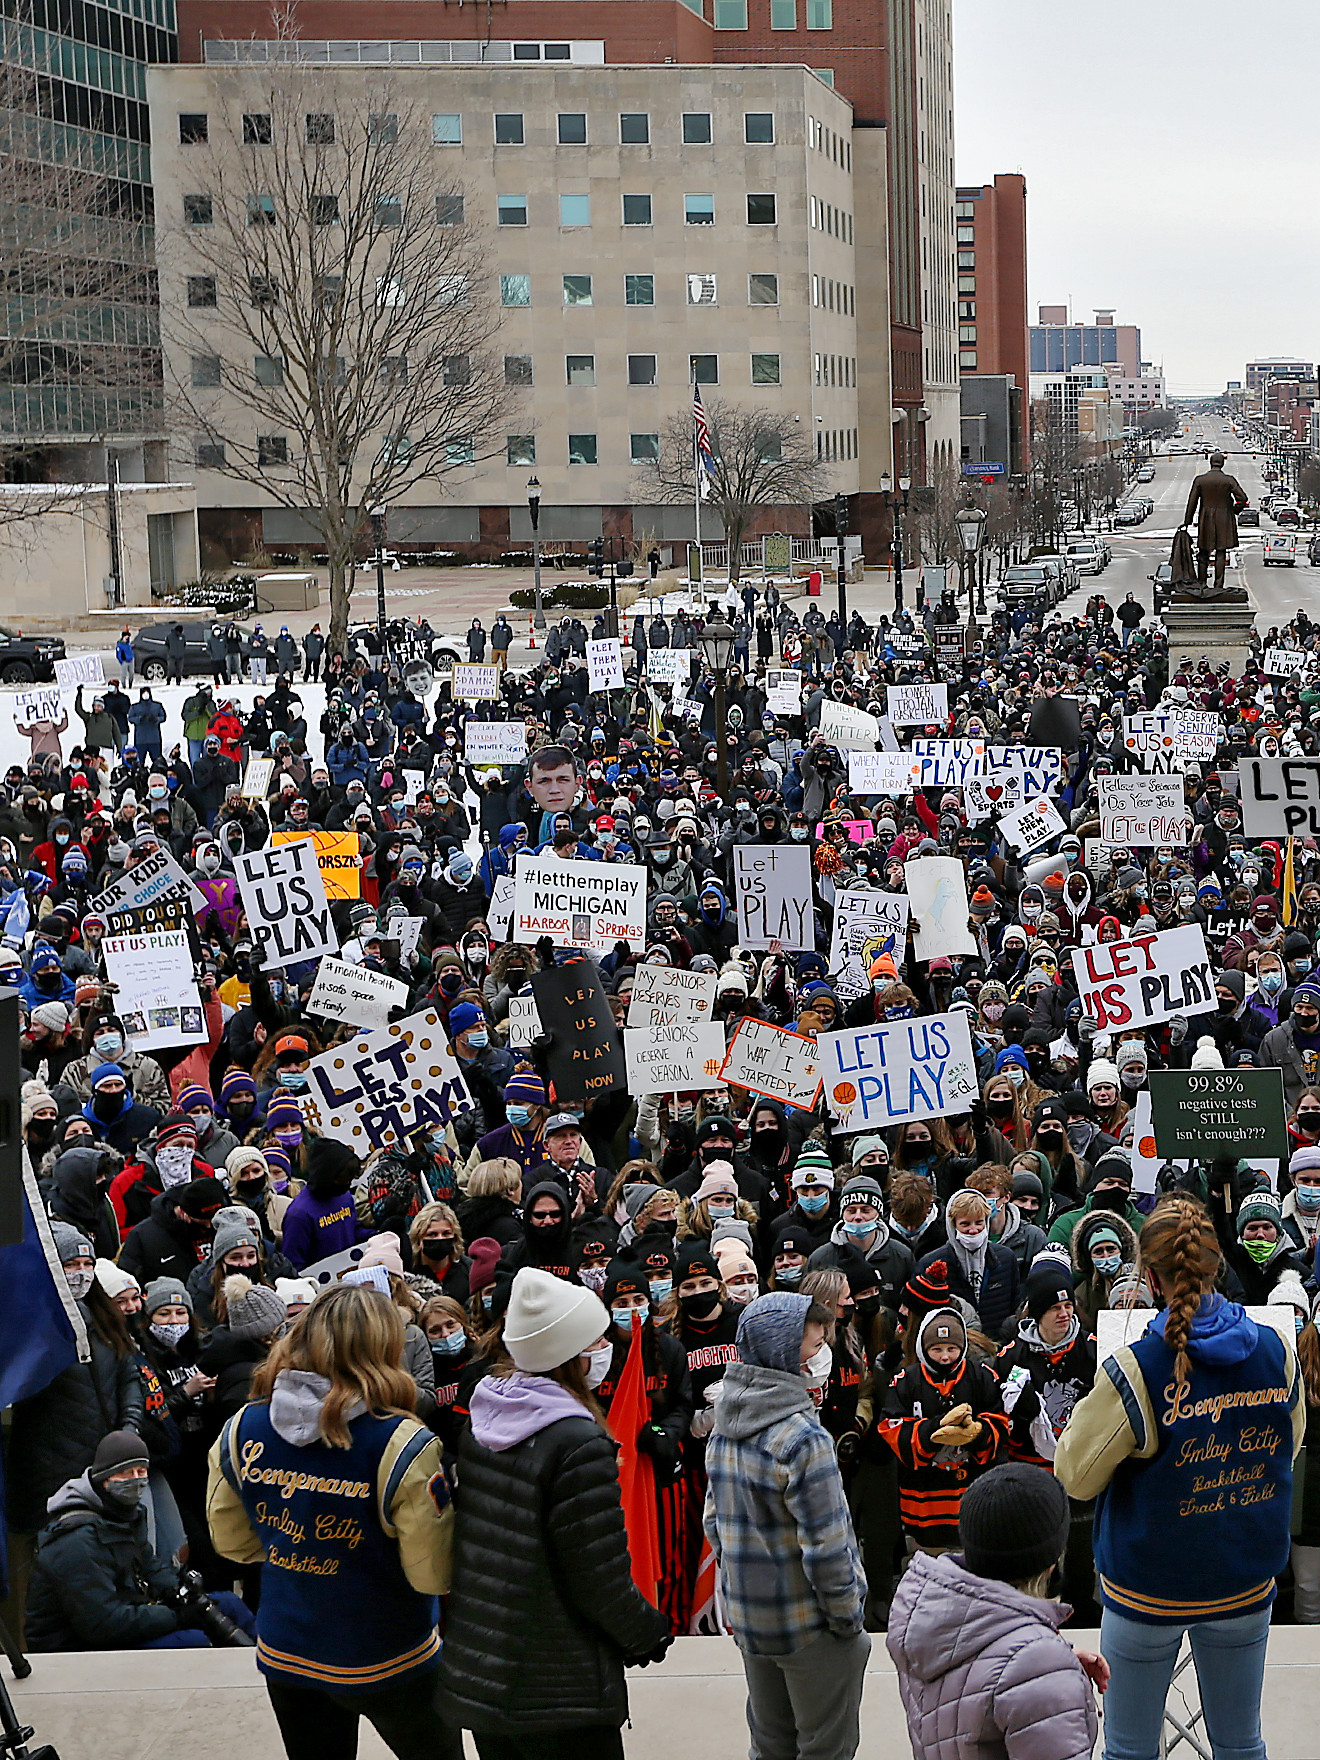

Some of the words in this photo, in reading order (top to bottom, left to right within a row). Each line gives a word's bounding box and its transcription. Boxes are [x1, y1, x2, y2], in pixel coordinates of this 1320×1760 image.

[596, 643, 613, 653] LET
[593, 655, 617, 664] THEM
[1271, 661, 1298, 675] PLAY
[457, 666, 473, 676] FIX
[478, 666, 495, 676] THE
[461, 676, 490, 685] DAMN
[594, 666, 617, 676] PLAY
[16, 693, 37, 706] LET
[38, 689, 61, 703] THEM
[455, 687, 496, 697] SPORTS!
[26, 700, 59, 721] PLAY
[1175, 710, 1217, 723] DESERVE
[822, 722, 877, 741] MATTER!
[1128, 715, 1170, 734] LET
[915, 741, 950, 757] LET
[953, 740, 974, 760] US
[1138, 733, 1161, 752] US
[1174, 734, 1216, 747] SEASON
[853, 755, 880, 767] WHEN
[988, 747, 1026, 769] LET
[1028, 746, 1060, 769] US
[864, 768, 876, 778] IT
[884, 768, 896, 778] BE
[921, 759, 980, 785] PLAY!
[862, 779, 878, 790] MY
[1102, 778, 1133, 793] Follow
[977, 801, 1014, 811] SPORTS
[1108, 795, 1126, 811] Do
[1156, 796, 1175, 809] Job
[1018, 812, 1036, 827] LET
[1019, 818, 1044, 835] THEM
[1102, 816, 1137, 843] LET
[1149, 816, 1186, 842] PLAY
[1025, 824, 1051, 844] PLAY!
[243, 842, 308, 883] LET
[739, 850, 779, 873] Let
[92, 885, 127, 914] OUR
[129, 852, 169, 887] KIDS
[134, 873, 173, 904] CHOICE
[524, 869, 639, 896] #letthemplay
[255, 876, 314, 922] US
[534, 892, 628, 916] MICHIGAN
[838, 894, 869, 915] LET
[875, 900, 901, 923] US
[112, 914, 133, 931] DID
[138, 906, 165, 923] YOU
[166, 902, 187, 917] GET
[519, 914, 570, 931] HARBOR
[595, 917, 643, 938] SPRINGS
[743, 896, 809, 949] PLAY
[1207, 914, 1237, 937] Let
[253, 909, 329, 958] PLAY
[563, 938, 605, 949] Rams!!
[105, 940, 125, 954] LET
[129, 938, 147, 951] US
[149, 934, 185, 949] PLAY!
[1085, 936, 1158, 983] LET
[369, 972, 395, 991] health
[663, 971, 707, 992] SENIOR
[351, 990, 376, 1001] space
[565, 987, 596, 1006] LET
[633, 988, 680, 1009] DESERVES
[1083, 984, 1133, 1031] US
[1140, 963, 1212, 1017] PLAY
[576, 1017, 597, 1031] US
[740, 1019, 765, 1040] LET
[771, 1031, 792, 1049] ME
[650, 1026, 699, 1044] SENIORS
[572, 1043, 612, 1061] PLAY
[636, 1047, 670, 1064] DESERVE
[686, 1047, 694, 1059] A
[834, 1030, 890, 1074] LET
[908, 1021, 950, 1062] US
[651, 1065, 694, 1083] SEASON.
[781, 1056, 794, 1073] I
[312, 1040, 410, 1110] LET
[585, 1073, 614, 1089] NOW
[738, 1065, 797, 1097] STARTED!
[1188, 1075, 1244, 1093] 99.8%
[859, 1061, 947, 1120] PLAY
[359, 1076, 472, 1149] PLAY!
[1179, 1097, 1228, 1112] negative
[1230, 1098, 1257, 1110] tests
[1199, 1113, 1240, 1125] STILL
[1176, 1127, 1201, 1140] isn't
[1203, 1127, 1266, 1143] enough???
[318, 1206, 352, 1230] #letusplay
[1162, 1380, 1289, 1426] Lengemann
[1175, 1434, 1233, 1467] Imlay
[1238, 1425, 1282, 1455] City
[240, 1439, 371, 1499] Lengemann
[1192, 1463, 1266, 1493] Basketball
[1179, 1492, 1226, 1517] Track
[1240, 1483, 1275, 1506] Field
[255, 1501, 306, 1544] Imlay
[315, 1515, 365, 1549] City
[268, 1544, 340, 1576] Basketball
